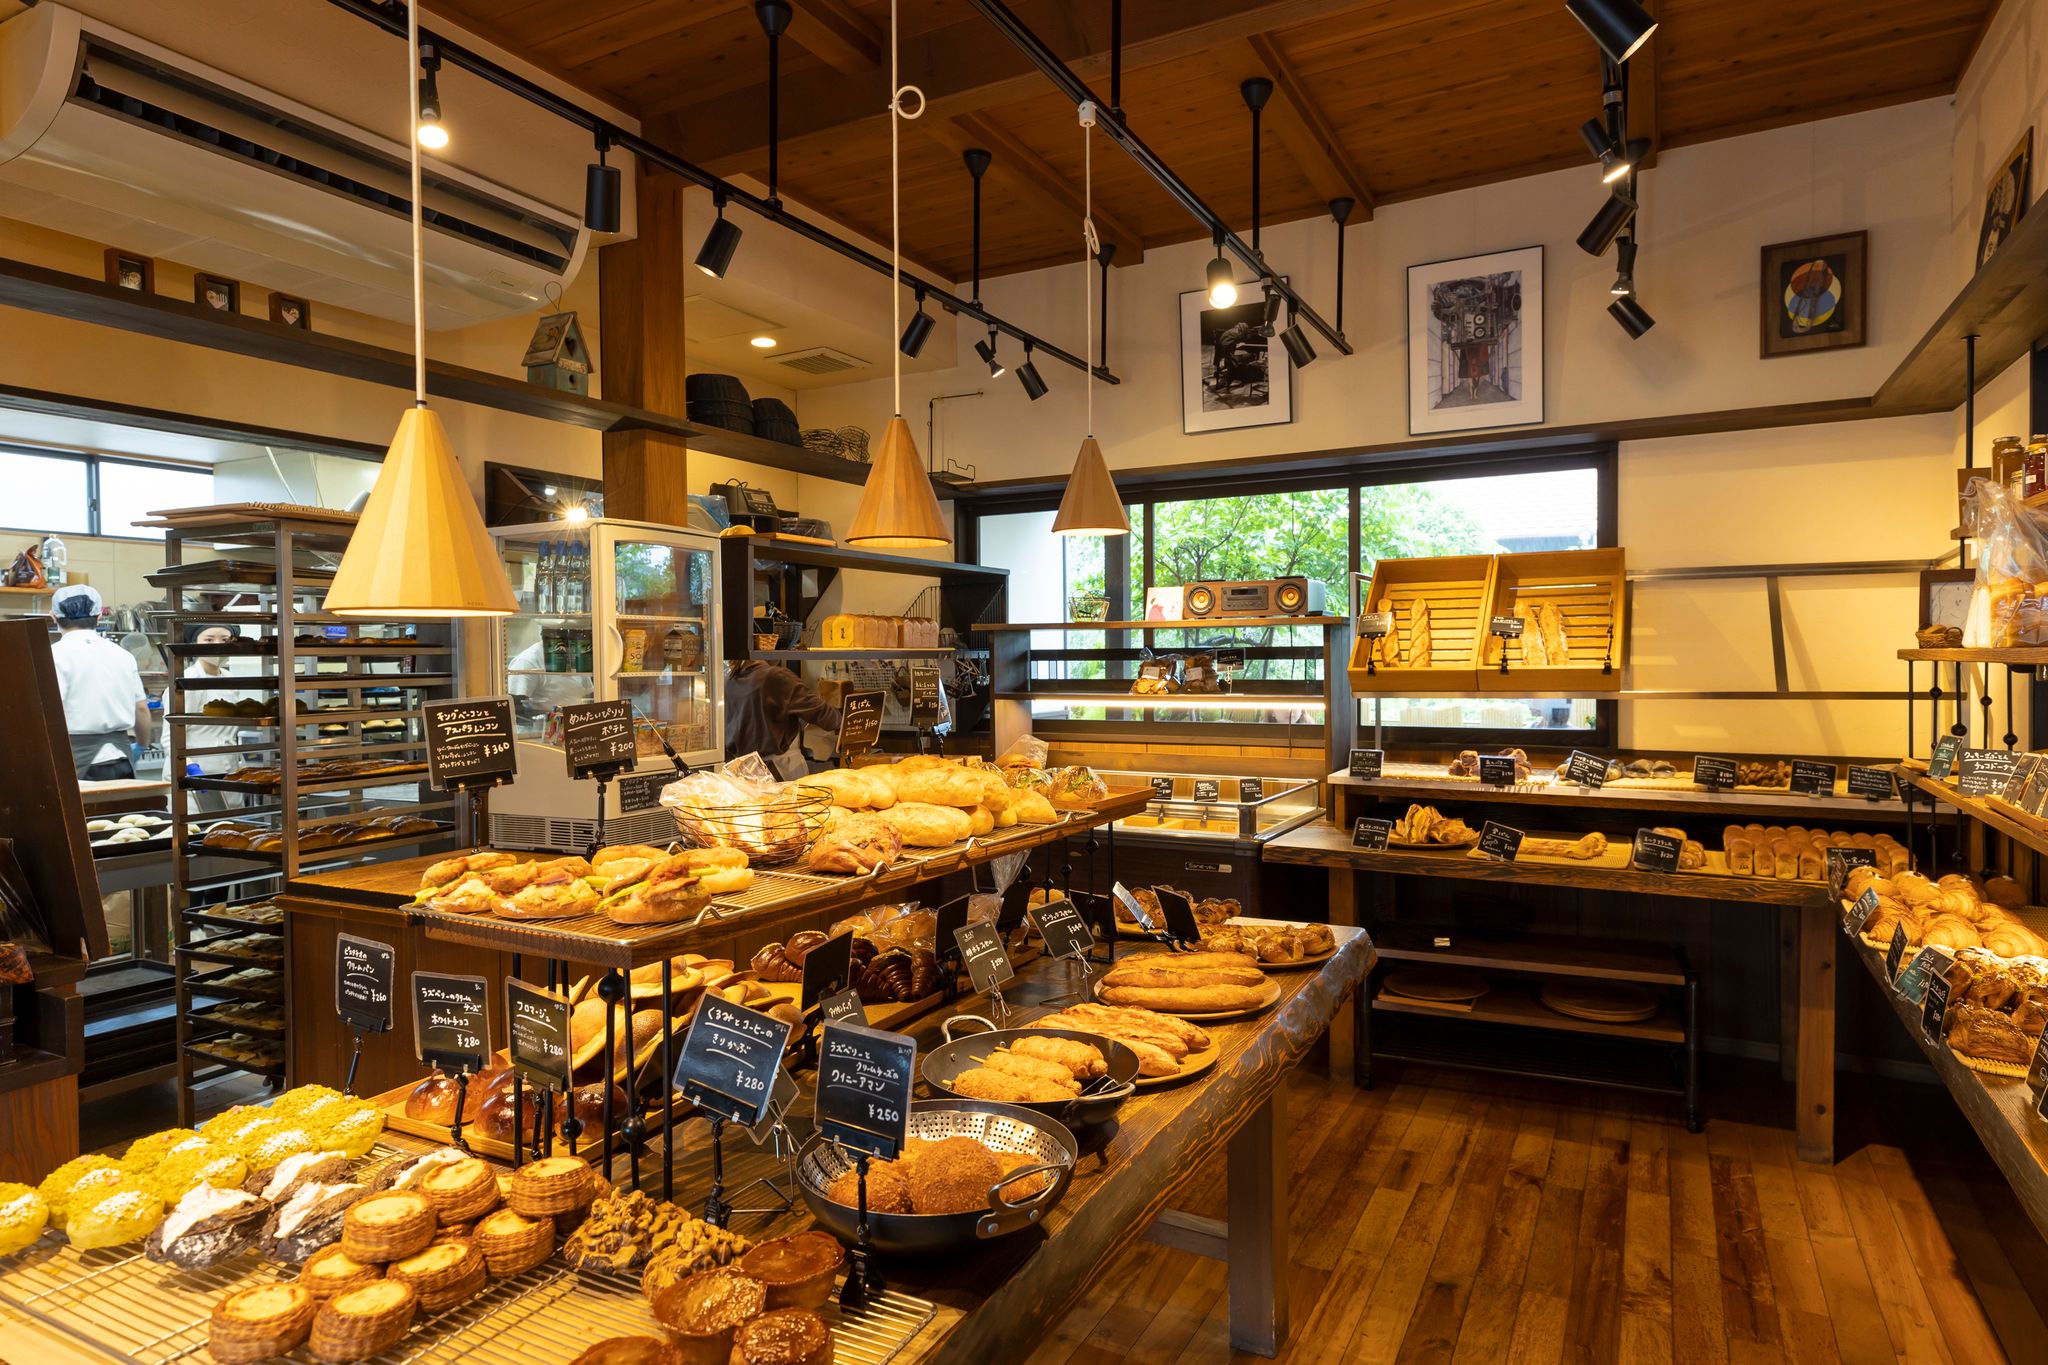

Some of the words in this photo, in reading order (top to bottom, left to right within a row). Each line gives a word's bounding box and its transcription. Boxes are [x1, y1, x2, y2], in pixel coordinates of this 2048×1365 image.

[437, 709, 489, 721] キングベーコンと
[569, 708, 624, 725] めんたいぴりり
[444, 723, 498, 735] アスパラレンコン
[601, 724, 625, 735] ポテト
[483, 742, 510, 757] ¥360
[610, 741, 634, 757] ¥200
[346, 961, 375, 973] クリームパン
[370, 988, 387, 1003] ¥260
[463, 1003, 482, 1012] チーズ
[516, 1001, 551, 1023] フロマージュ
[431, 1013, 469, 1026] ホワイトチョコ
[707, 1006, 774, 1039] くるみとコーヒーの
[456, 1033, 481, 1049] ¥280
[542, 1038, 564, 1056] ¥280
[712, 1033, 752, 1055] きりかぶ
[830, 1041, 871, 1059] ラズベリーと
[735, 1070, 765, 1091] ¥280
[868, 1103, 899, 1122] ¥250
